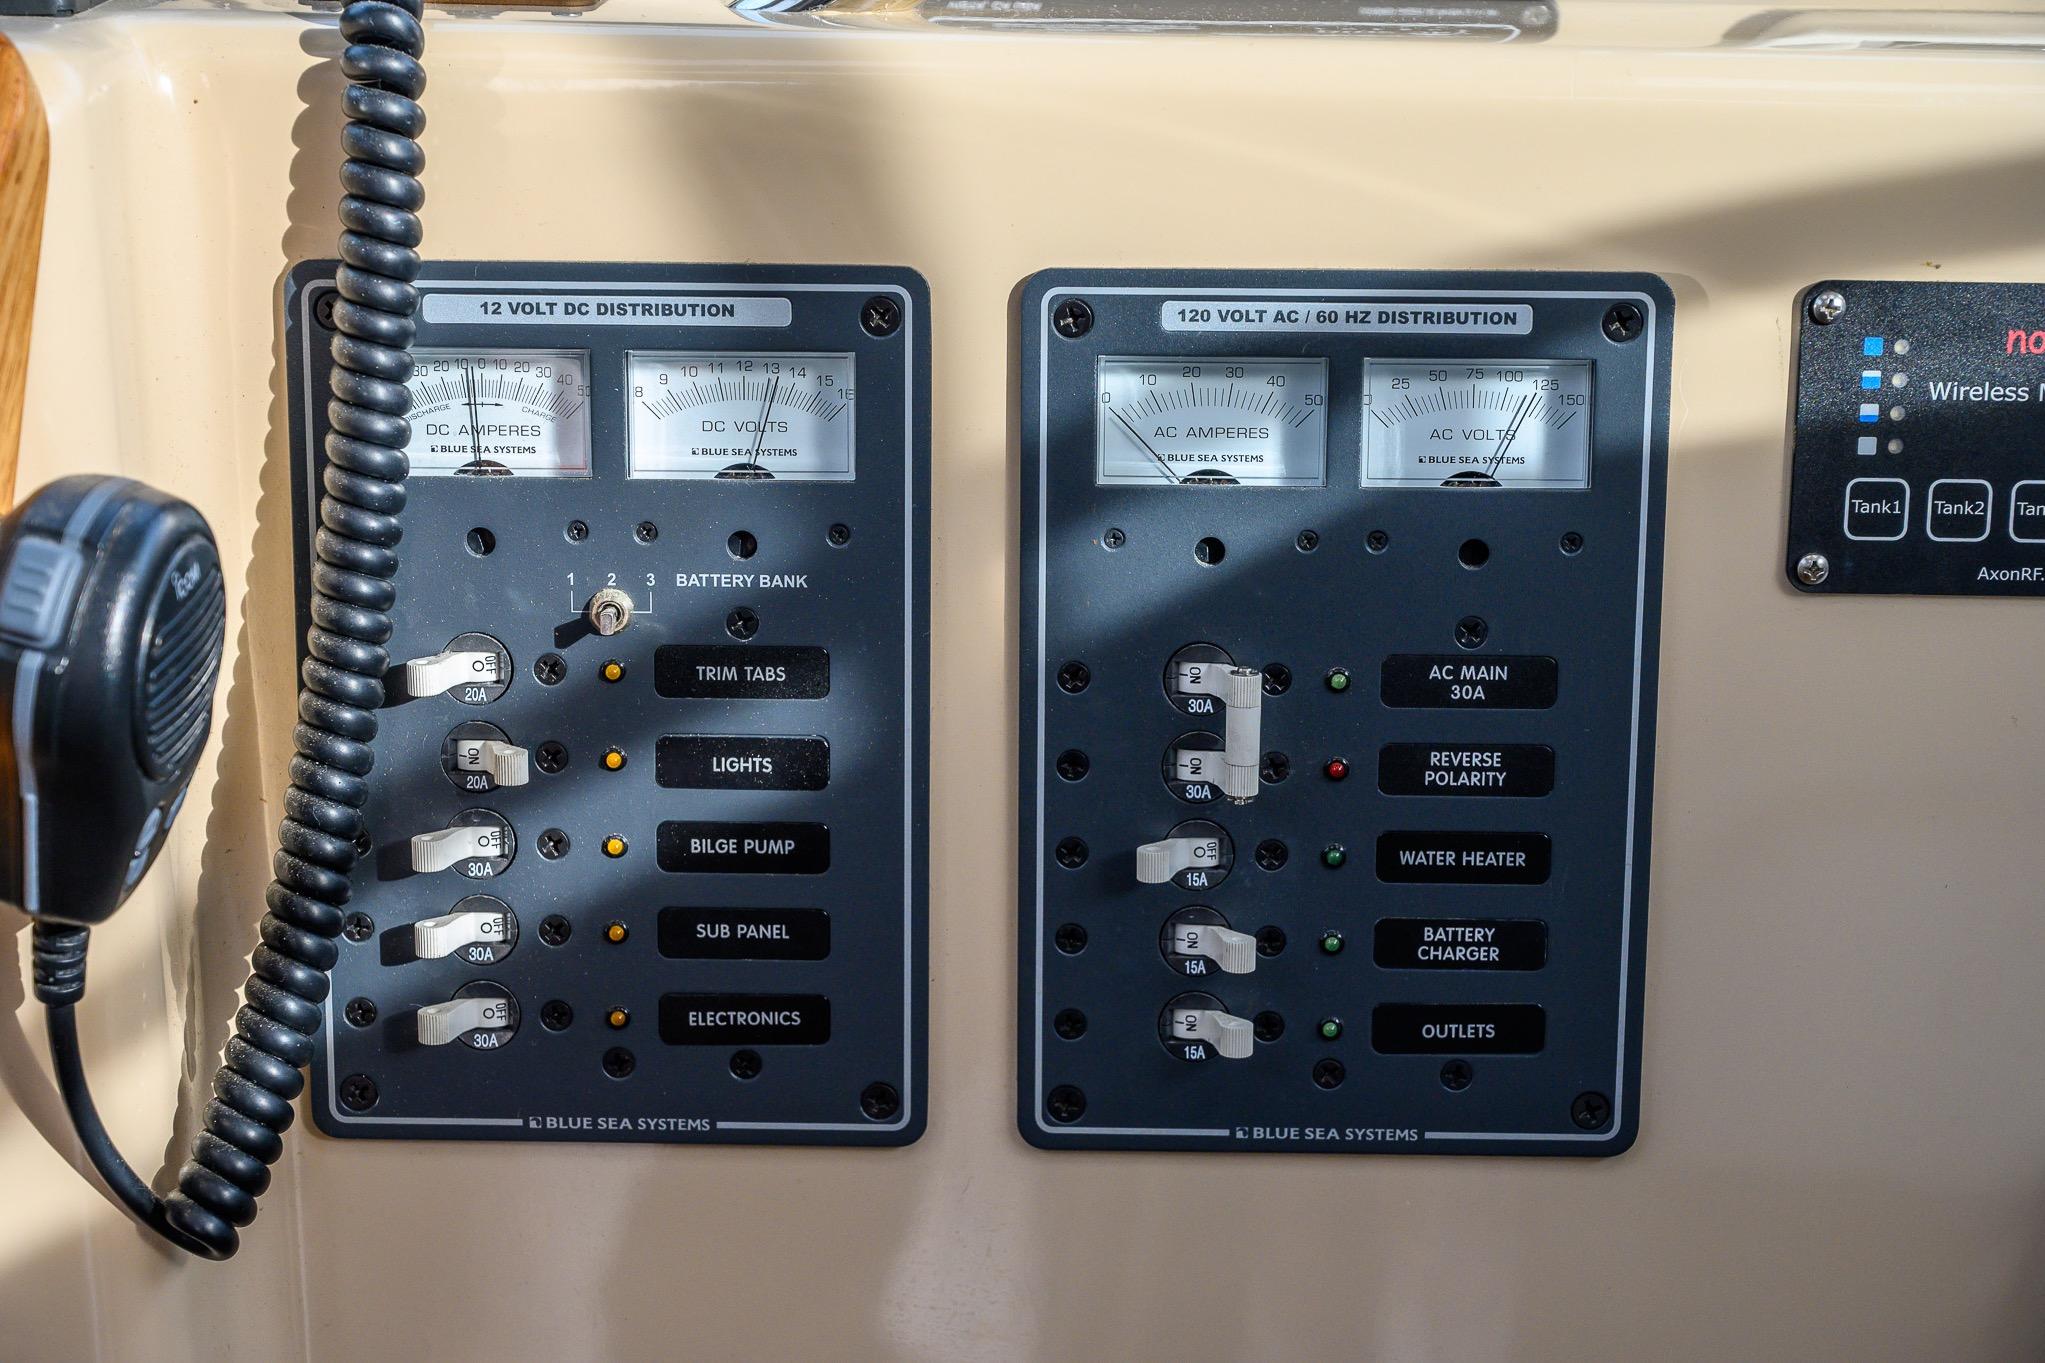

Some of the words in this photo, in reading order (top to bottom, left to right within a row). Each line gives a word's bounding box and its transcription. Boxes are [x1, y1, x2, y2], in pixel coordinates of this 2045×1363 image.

[480, 301, 502, 315] 12
[508, 302, 557, 316] VOLT
[564, 302, 590, 316] DC
[597, 303, 736, 318] DISTRIBUTION
[1177, 309, 1211, 323] 120
[1218, 310, 1267, 324] VOLT
[1273, 310, 1300, 324] AC
[1304, 310, 1311, 324] /
[1316, 310, 1338, 324] 60
[1345, 310, 1371, 325] HZ
[1377, 311, 1517, 326] DISTRIBUTION
[413, 365, 428, 377] 30
[433, 360, 449, 372] 20
[455, 358, 469, 370] 10
[477, 358, 486, 370] 0
[493, 358, 507, 370] 10
[514, 362, 530, 373] 20
[535, 366, 552, 378] 30
[557, 374, 573, 386] 40
[635, 386, 643, 398] 8
[659, 374, 668, 385] 9
[681, 366, 698, 378] 10
[708, 362, 724, 374] 11
[736, 361, 753, 372] 12
[763, 363, 780, 374] 13
[789, 367, 807, 379] 14
[816, 375, 834, 387] 15
[1101, 392, 1111, 404] 0
[1139, 374, 1157, 386] 10
[1182, 366, 1201, 378] 20
[1225, 366, 1244, 378] 30
[1266, 375, 1286, 387] 40
[1304, 394, 1324, 406] 50
[1391, 378, 1410, 390] 25
[1429, 370, 1447, 382] 50
[1466, 368, 1484, 380] 75
[1497, 371, 1524, 382] 100
[1532, 379, 1559, 391] 125
[1558, 394, 1585, 406] 150
[1929, 381, 2029, 401] Wireless
[522, 406, 557, 423] CHARGE
[426, 424, 450, 436] DC
[459, 424, 541, 436] AMPERES
[702, 421, 725, 432] DC
[734, 421, 788, 433] VOLTS
[1154, 426, 1177, 438] AC
[1185, 427, 1269, 439] AMPERES
[1430, 429, 1453, 440] AC
[1462, 429, 1516, 441] VOLTS
[440, 445, 467, 453] BLUE
[470, 445, 491, 453] SEA
[493, 446, 537, 454] SYSTEMS
[701, 448, 729, 456] BLUE
[731, 448, 751, 456] SEA
[755, 449, 798, 457] SYSTEMS
[1167, 454, 1195, 462] BLUE
[1197, 454, 1218, 462] SEA
[1221, 454, 1264, 463] SYSTEMS
[1428, 456, 1456, 464] BLUE
[1458, 456, 1479, 464] SEA
[1482, 456, 1525, 465] SYSTEMS
[1851, 499, 1901, 514] Tank1
[1934, 500, 1985, 515] Tank2
[567, 573, 574, 585] 1
[607, 573, 616, 586] 2
[646, 573, 656, 586] 3
[676, 574, 755, 588] BATTERY
[759, 574, 808, 588] BANK
[485, 655, 497, 674] OFF
[696, 666, 737, 681] TRIM
[744, 666, 786, 682] TABS
[1189, 666, 1201, 684] ON
[1429, 665, 1454, 680] AC
[1460, 665, 1508, 681] MAIN
[465, 687, 487, 702] 20A
[1451, 685, 1485, 700] 30A
[1188, 699, 1214, 713] 30A
[468, 747, 480, 765] ON
[1430, 752, 1501, 767] REVERSE
[712, 757, 773, 773] LIGHTS
[1190, 757, 1202, 775] ON
[466, 776, 489, 790] 20A
[1424, 771, 1507, 787] POLARITY
[1185, 785, 1212, 799] 30A
[490, 830, 502, 849] OFF
[690, 839, 738, 854] BILGE
[744, 839, 795, 855] PUMP
[1206, 841, 1217, 860] OFF
[1399, 850, 1456, 866] WATER
[1462, 852, 1526, 867] HEATER
[468, 862, 493, 876] 30A
[1186, 873, 1208, 887] 15A
[493, 917, 504, 936] OFF
[696, 924, 731, 939] SUB
[737, 924, 790, 940] PANEL
[1187, 931, 1198, 949] ON
[1424, 927, 1496, 942] BATTERY
[469, 947, 494, 961] 30A
[1417, 946, 1500, 961] CHARGER
[1185, 960, 1206, 974] 15A
[496, 1003, 507, 1022] OFF
[688, 1011, 801, 1026] ELECTRONICS
[1185, 1015, 1197, 1032] ON
[1422, 1024, 1496, 1039] OUTLETS
[473, 1033, 499, 1048] 30A
[1184, 1046, 1205, 1060] 15A
[546, 1117, 593, 1129] BLUE
[597, 1117, 633, 1130] SEA
[637, 1118, 711, 1131] SYSTEMS
[1252, 1127, 1300, 1139] BLUE
[1304, 1128, 1340, 1140] SEA
[1345, 1128, 1418, 1141] SYSTEMS
